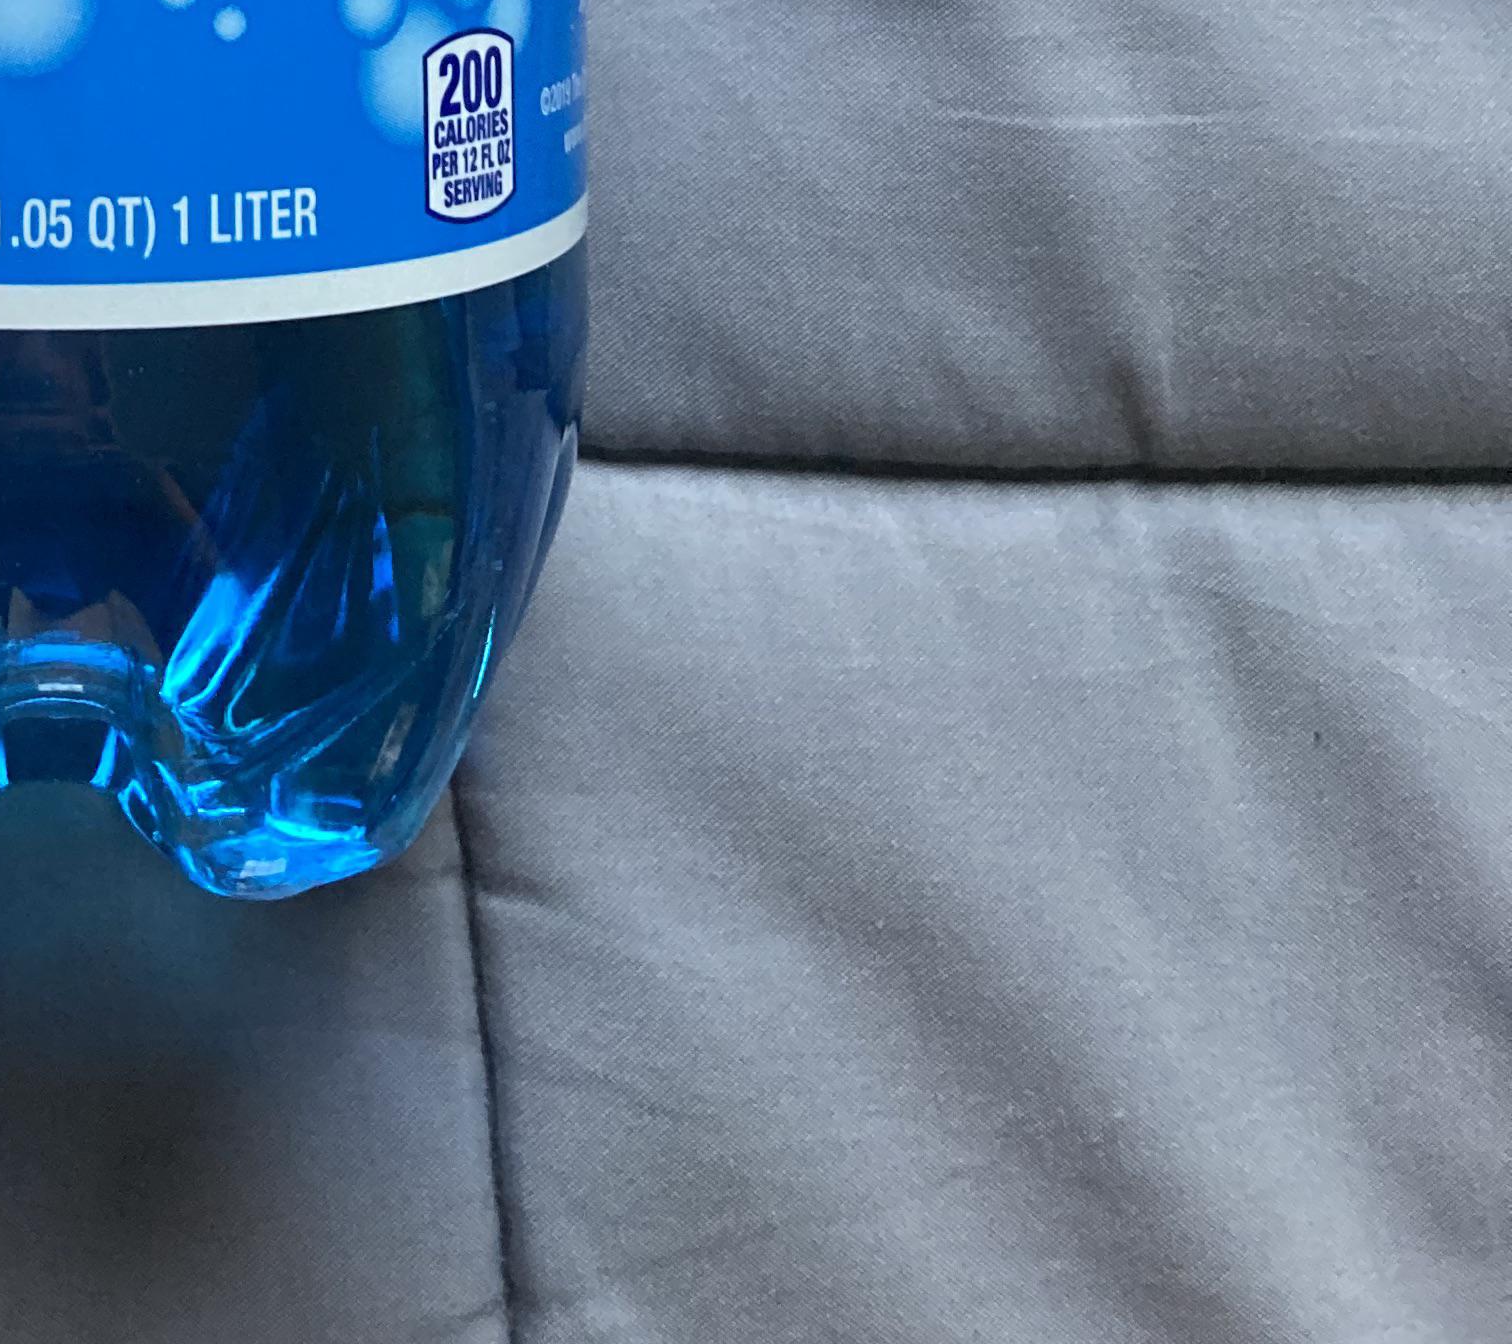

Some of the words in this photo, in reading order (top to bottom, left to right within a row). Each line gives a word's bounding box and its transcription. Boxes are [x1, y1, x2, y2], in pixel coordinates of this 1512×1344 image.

[438, 45, 503, 117] 200
[434, 108, 509, 149] CALORIES
[433, 150, 458, 179] PER
[462, 147, 477, 175] 12
[481, 142, 494, 169] FL
[497, 138, 511, 166] OZ
[444, 170, 503, 208] SERVING
[88, 196, 156, 258] QT)
[172, 196, 189, 244] 1
[210, 187, 317, 244] LITER
